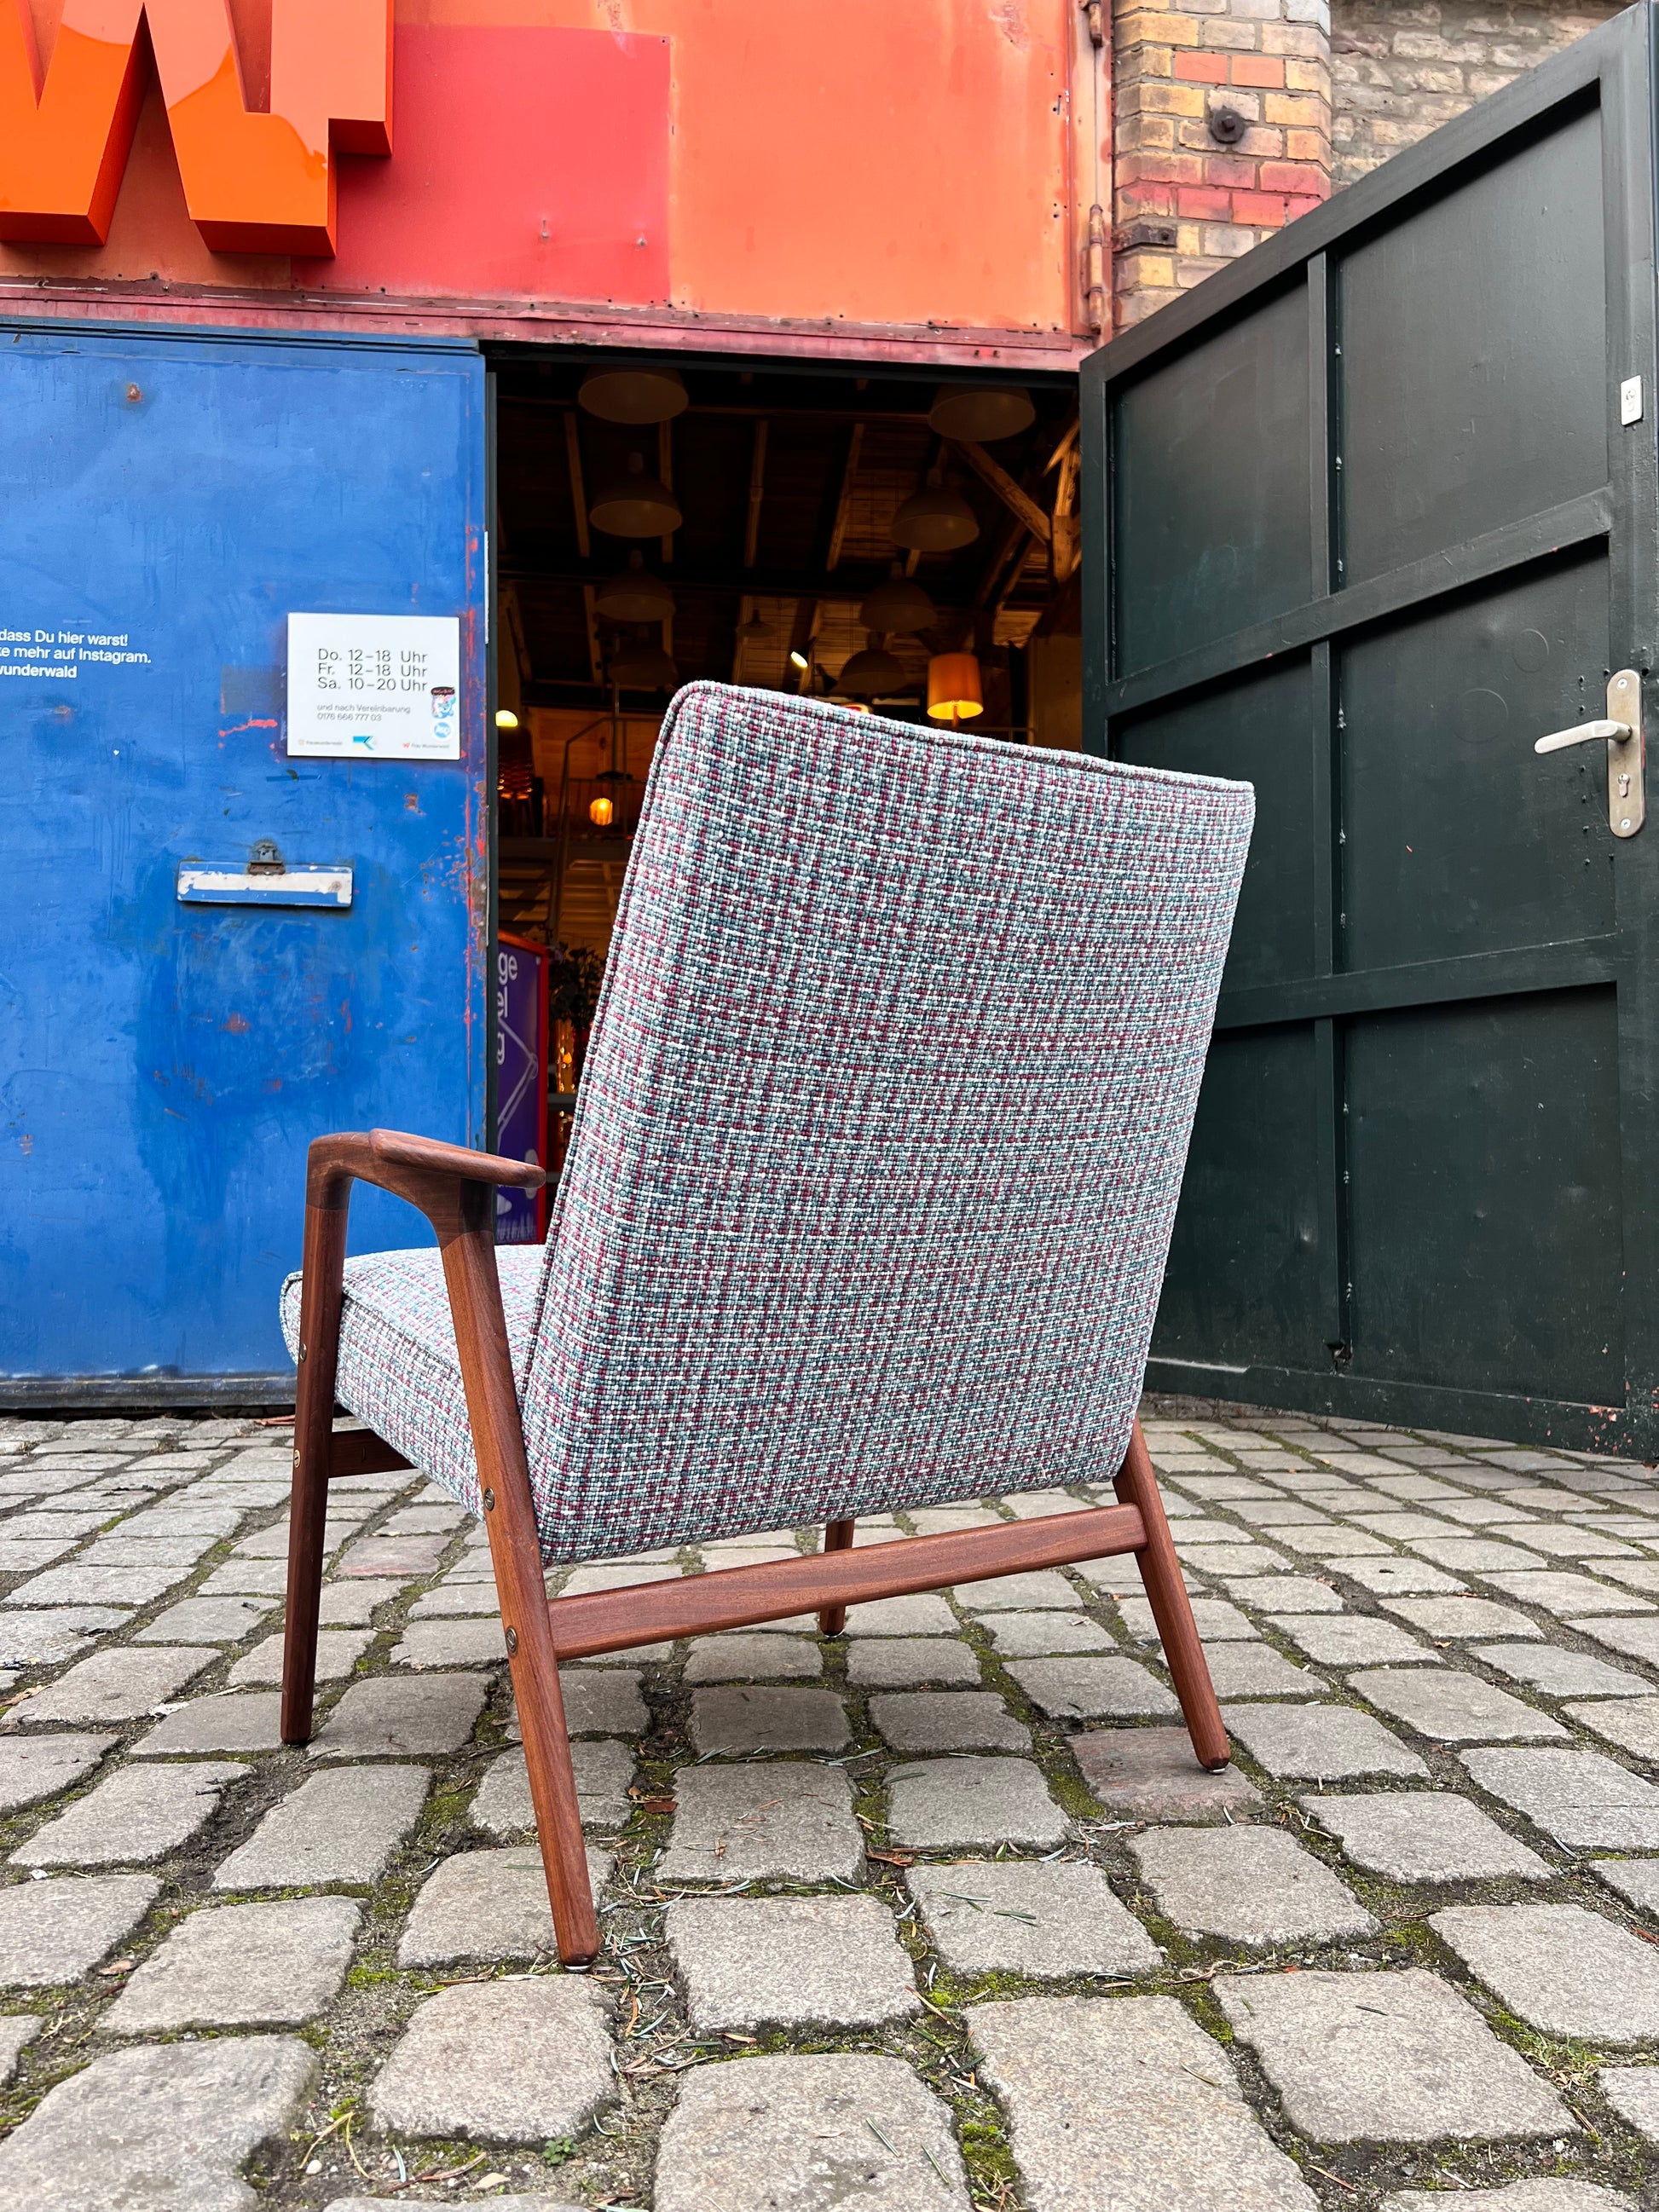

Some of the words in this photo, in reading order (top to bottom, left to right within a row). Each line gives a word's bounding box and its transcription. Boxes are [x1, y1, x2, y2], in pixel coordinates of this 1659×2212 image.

[0, 629, 31, 642] dass
[35, 630, 54, 644] Du
[58, 631, 84, 644] hier
[87, 634, 128, 646] warst!
[14, 646, 50, 659] mehr
[54, 648, 76, 661] auf
[79, 648, 152, 665] Instagram.
[318, 648, 342, 661] Do.
[401, 650, 428, 663] Uhr
[318, 662, 335, 675] Fr.
[401, 664, 428, 678] Uhr
[317, 676, 341, 690] Sa.
[401, 679, 428, 691] Uhr
[356, 705, 411, 714] Vereinbarung
